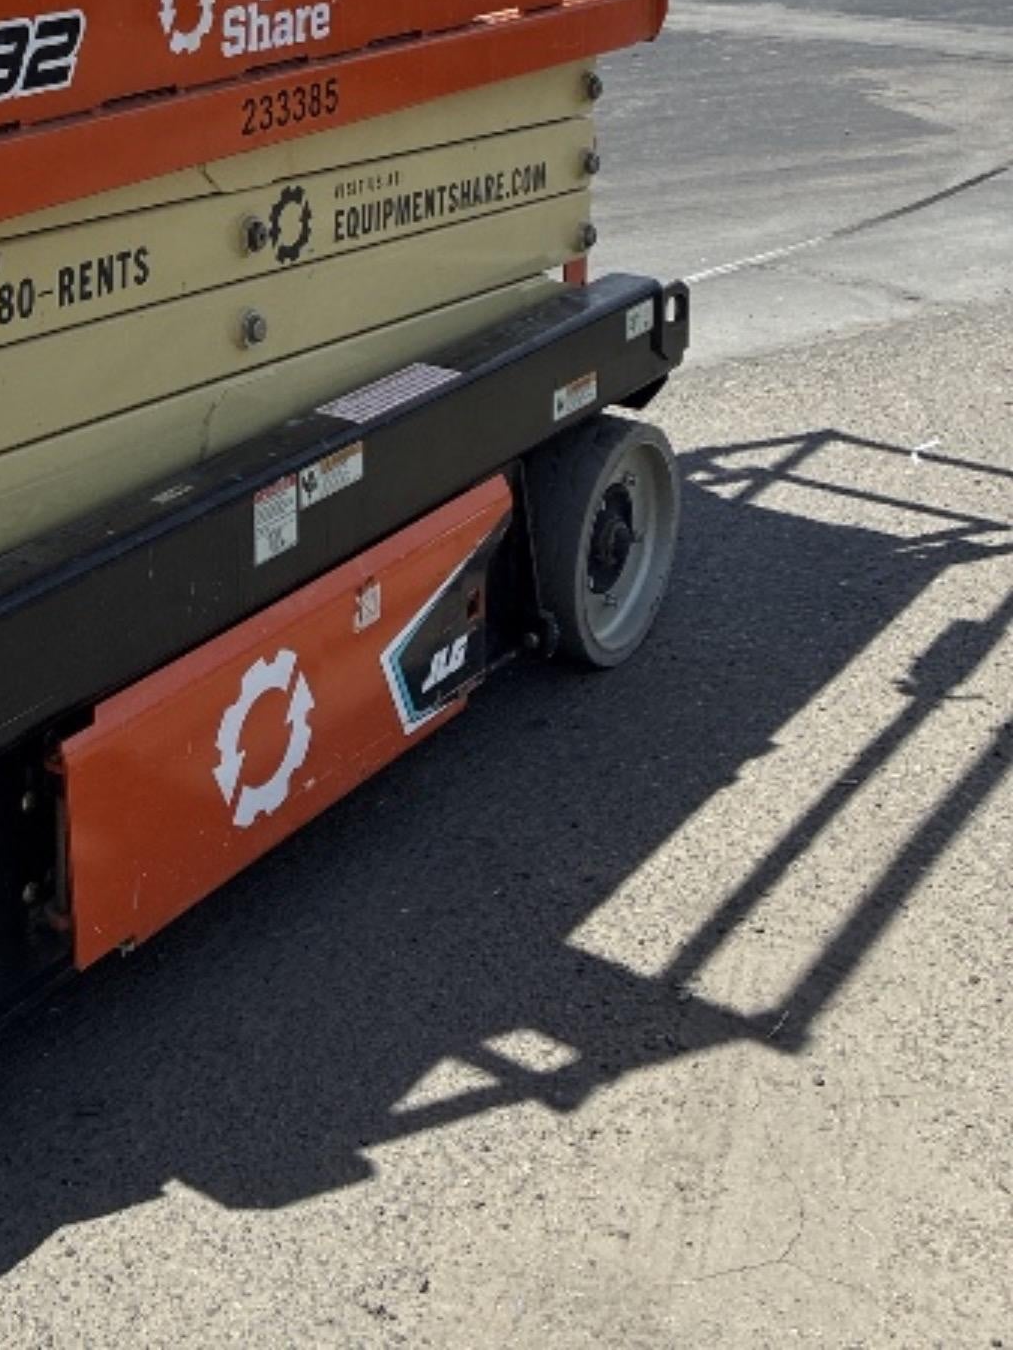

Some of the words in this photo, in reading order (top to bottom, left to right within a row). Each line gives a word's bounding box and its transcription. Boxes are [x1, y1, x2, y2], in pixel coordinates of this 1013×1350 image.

[220, 0, 331, 58] Share
[241, 77, 340, 137] 233385
[333, 161, 547, 243] EQUIPMENTSHARE.COM
